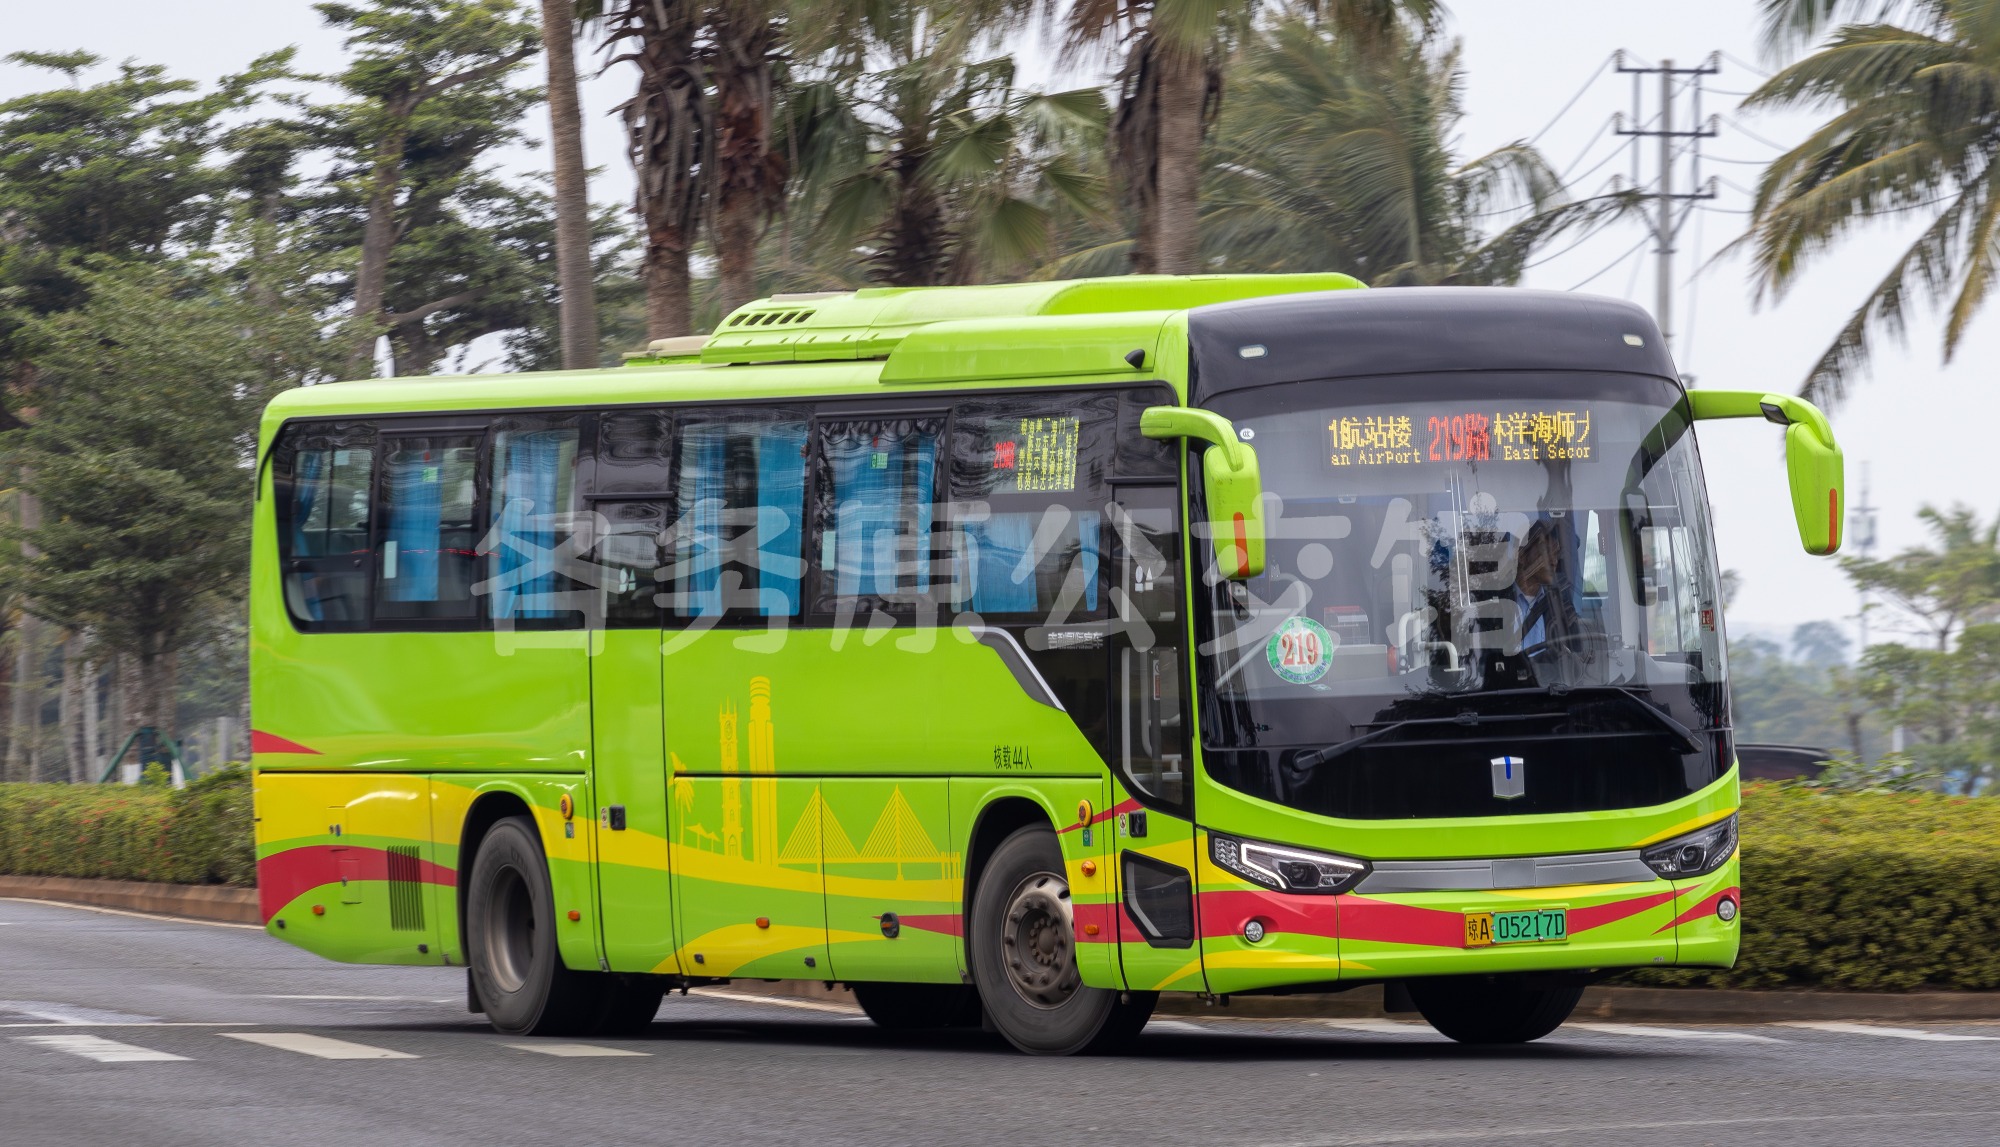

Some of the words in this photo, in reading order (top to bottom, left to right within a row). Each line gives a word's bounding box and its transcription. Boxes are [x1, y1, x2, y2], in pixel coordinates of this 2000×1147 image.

[1428, 412, 1489, 461] 219路
[1331, 454, 1350, 466] an
[1503, 444, 1539, 460] East
[1281, 633, 1319, 666] 219
